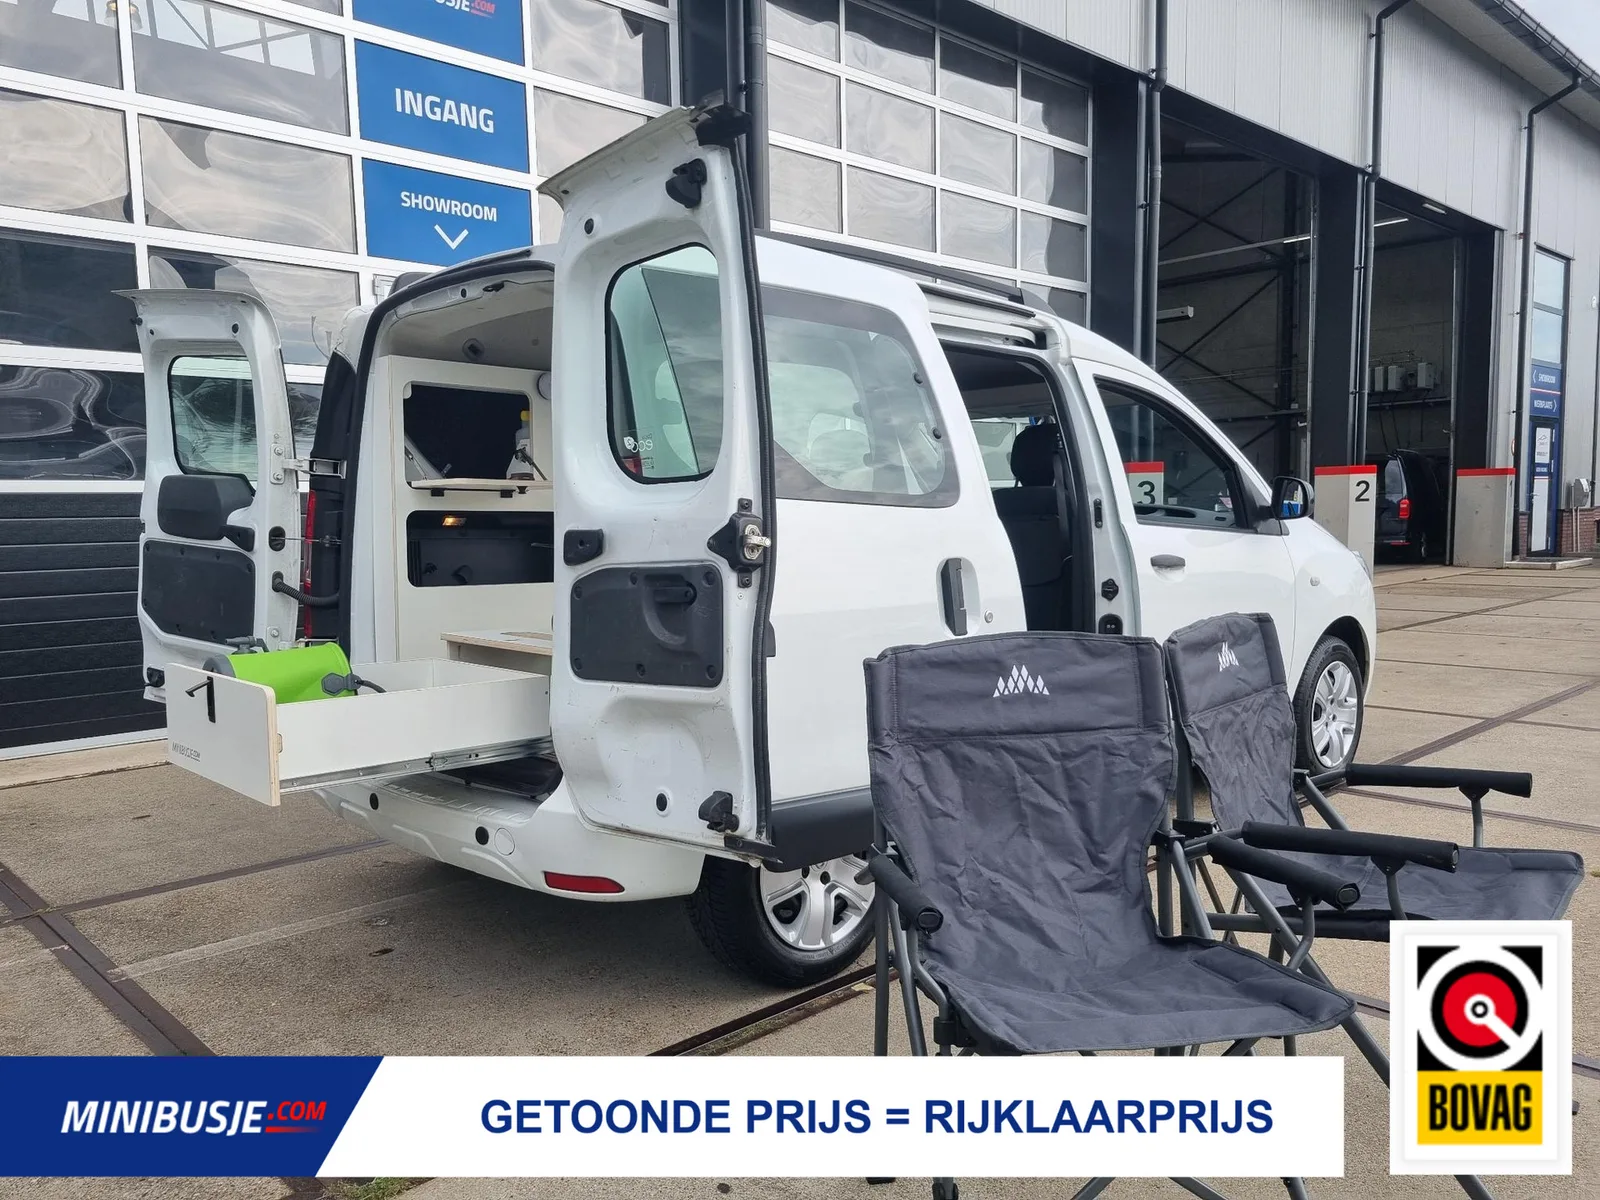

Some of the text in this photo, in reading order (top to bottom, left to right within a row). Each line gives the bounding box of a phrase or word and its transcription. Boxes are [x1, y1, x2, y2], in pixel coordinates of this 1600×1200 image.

[395, 88, 494, 134] INGANG
[400, 191, 498, 222] SHOWROOM
[1136, 480, 1156, 504] 3
[1354, 480, 1371, 502] 2
